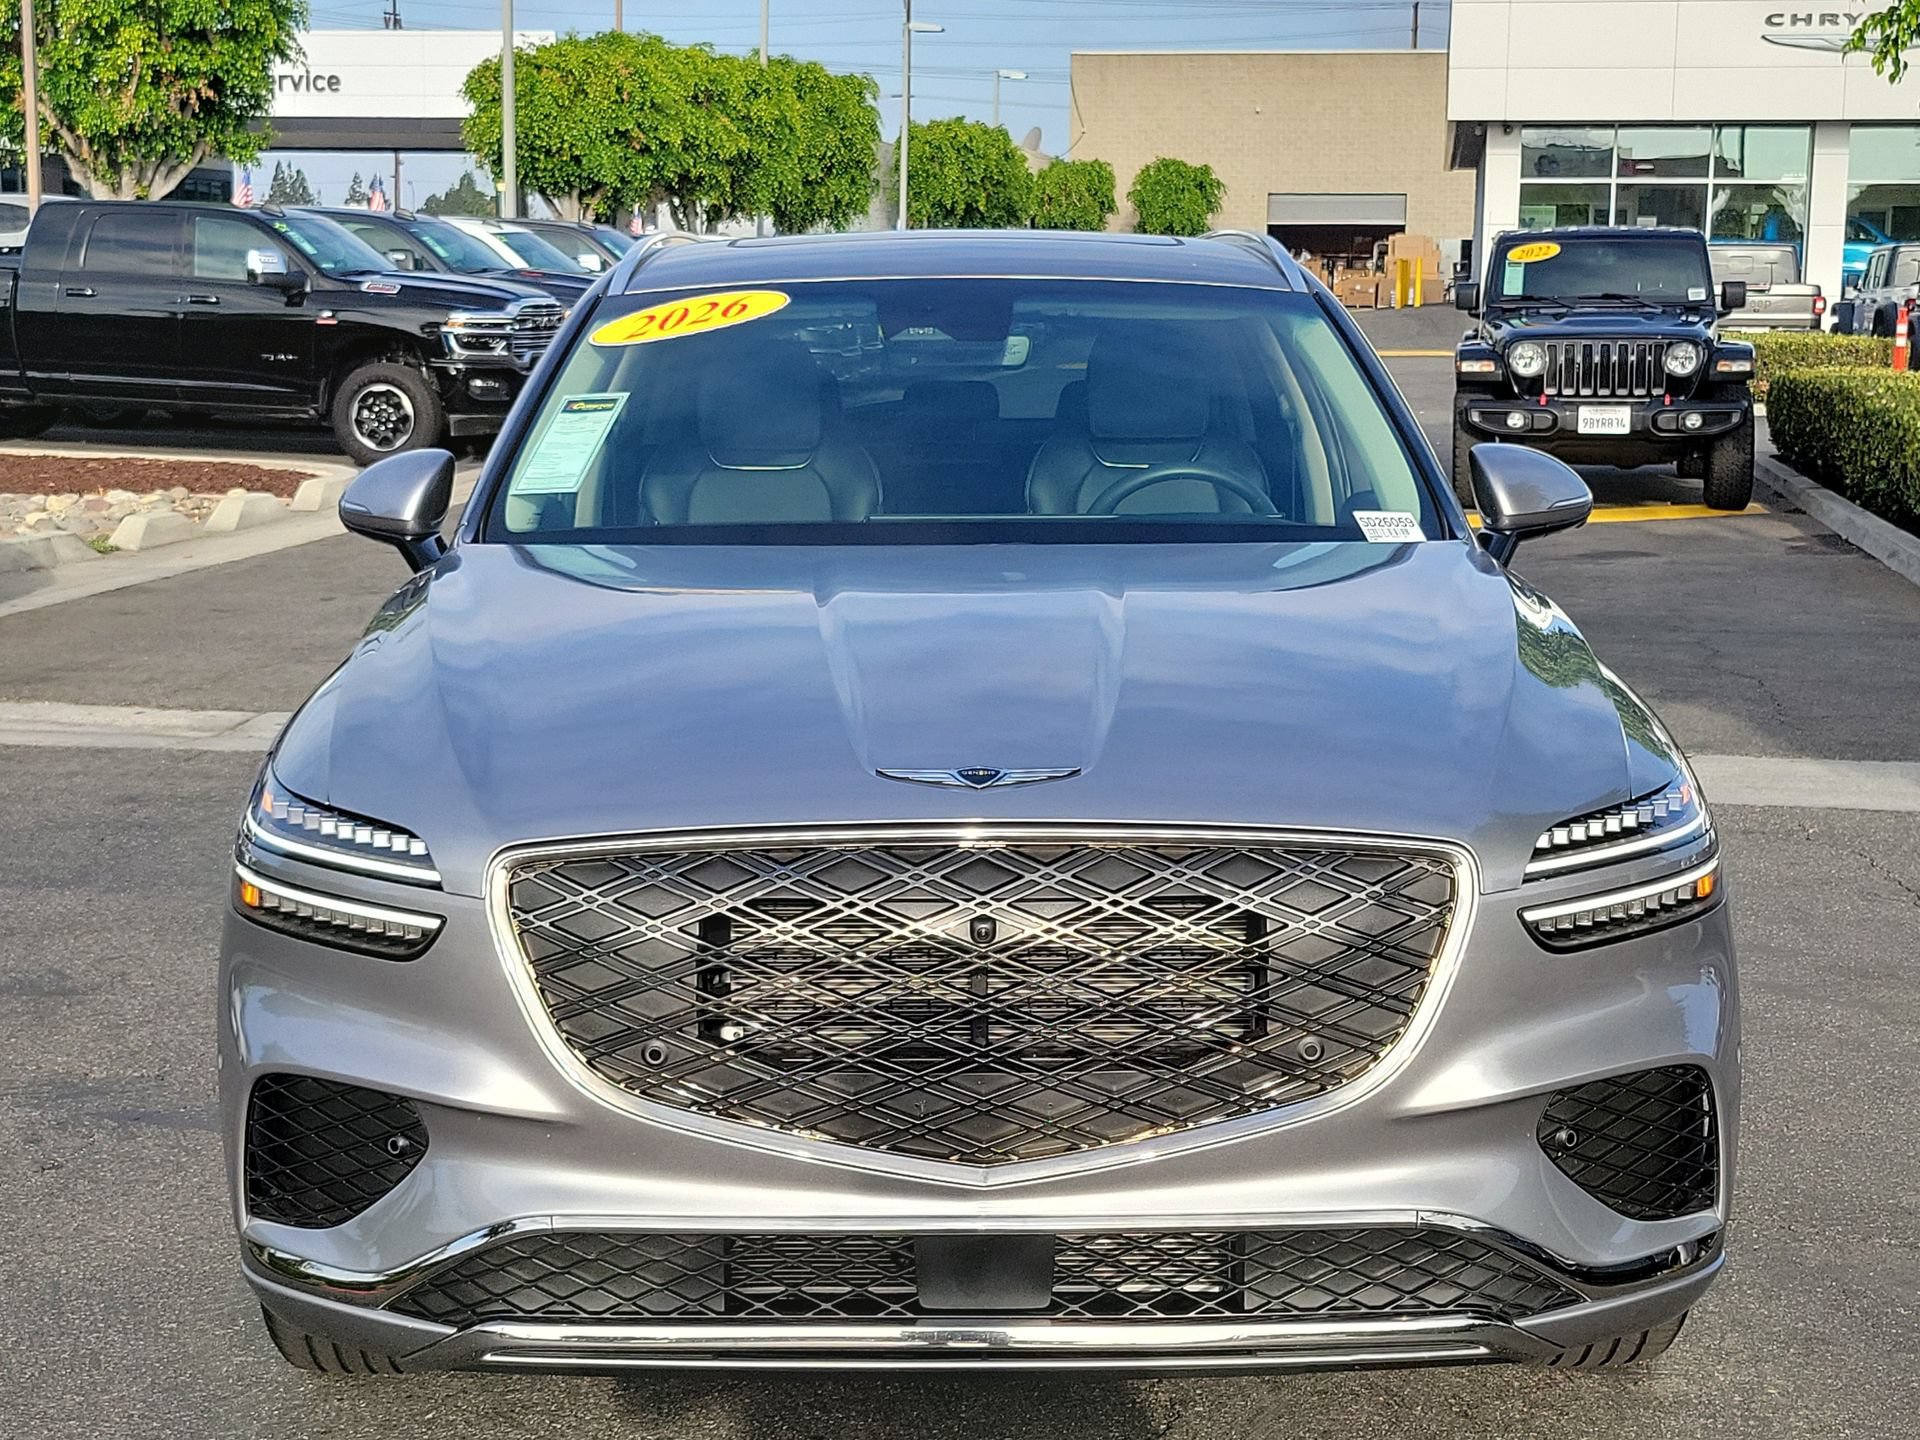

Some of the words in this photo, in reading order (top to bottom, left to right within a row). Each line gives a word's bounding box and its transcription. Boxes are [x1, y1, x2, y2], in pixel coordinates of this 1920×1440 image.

[1765, 13, 1863, 27] CHRY
[1517, 245, 1551, 260] 2022
[623, 295, 754, 341] 2026
[1359, 516, 1415, 528] SD26059
